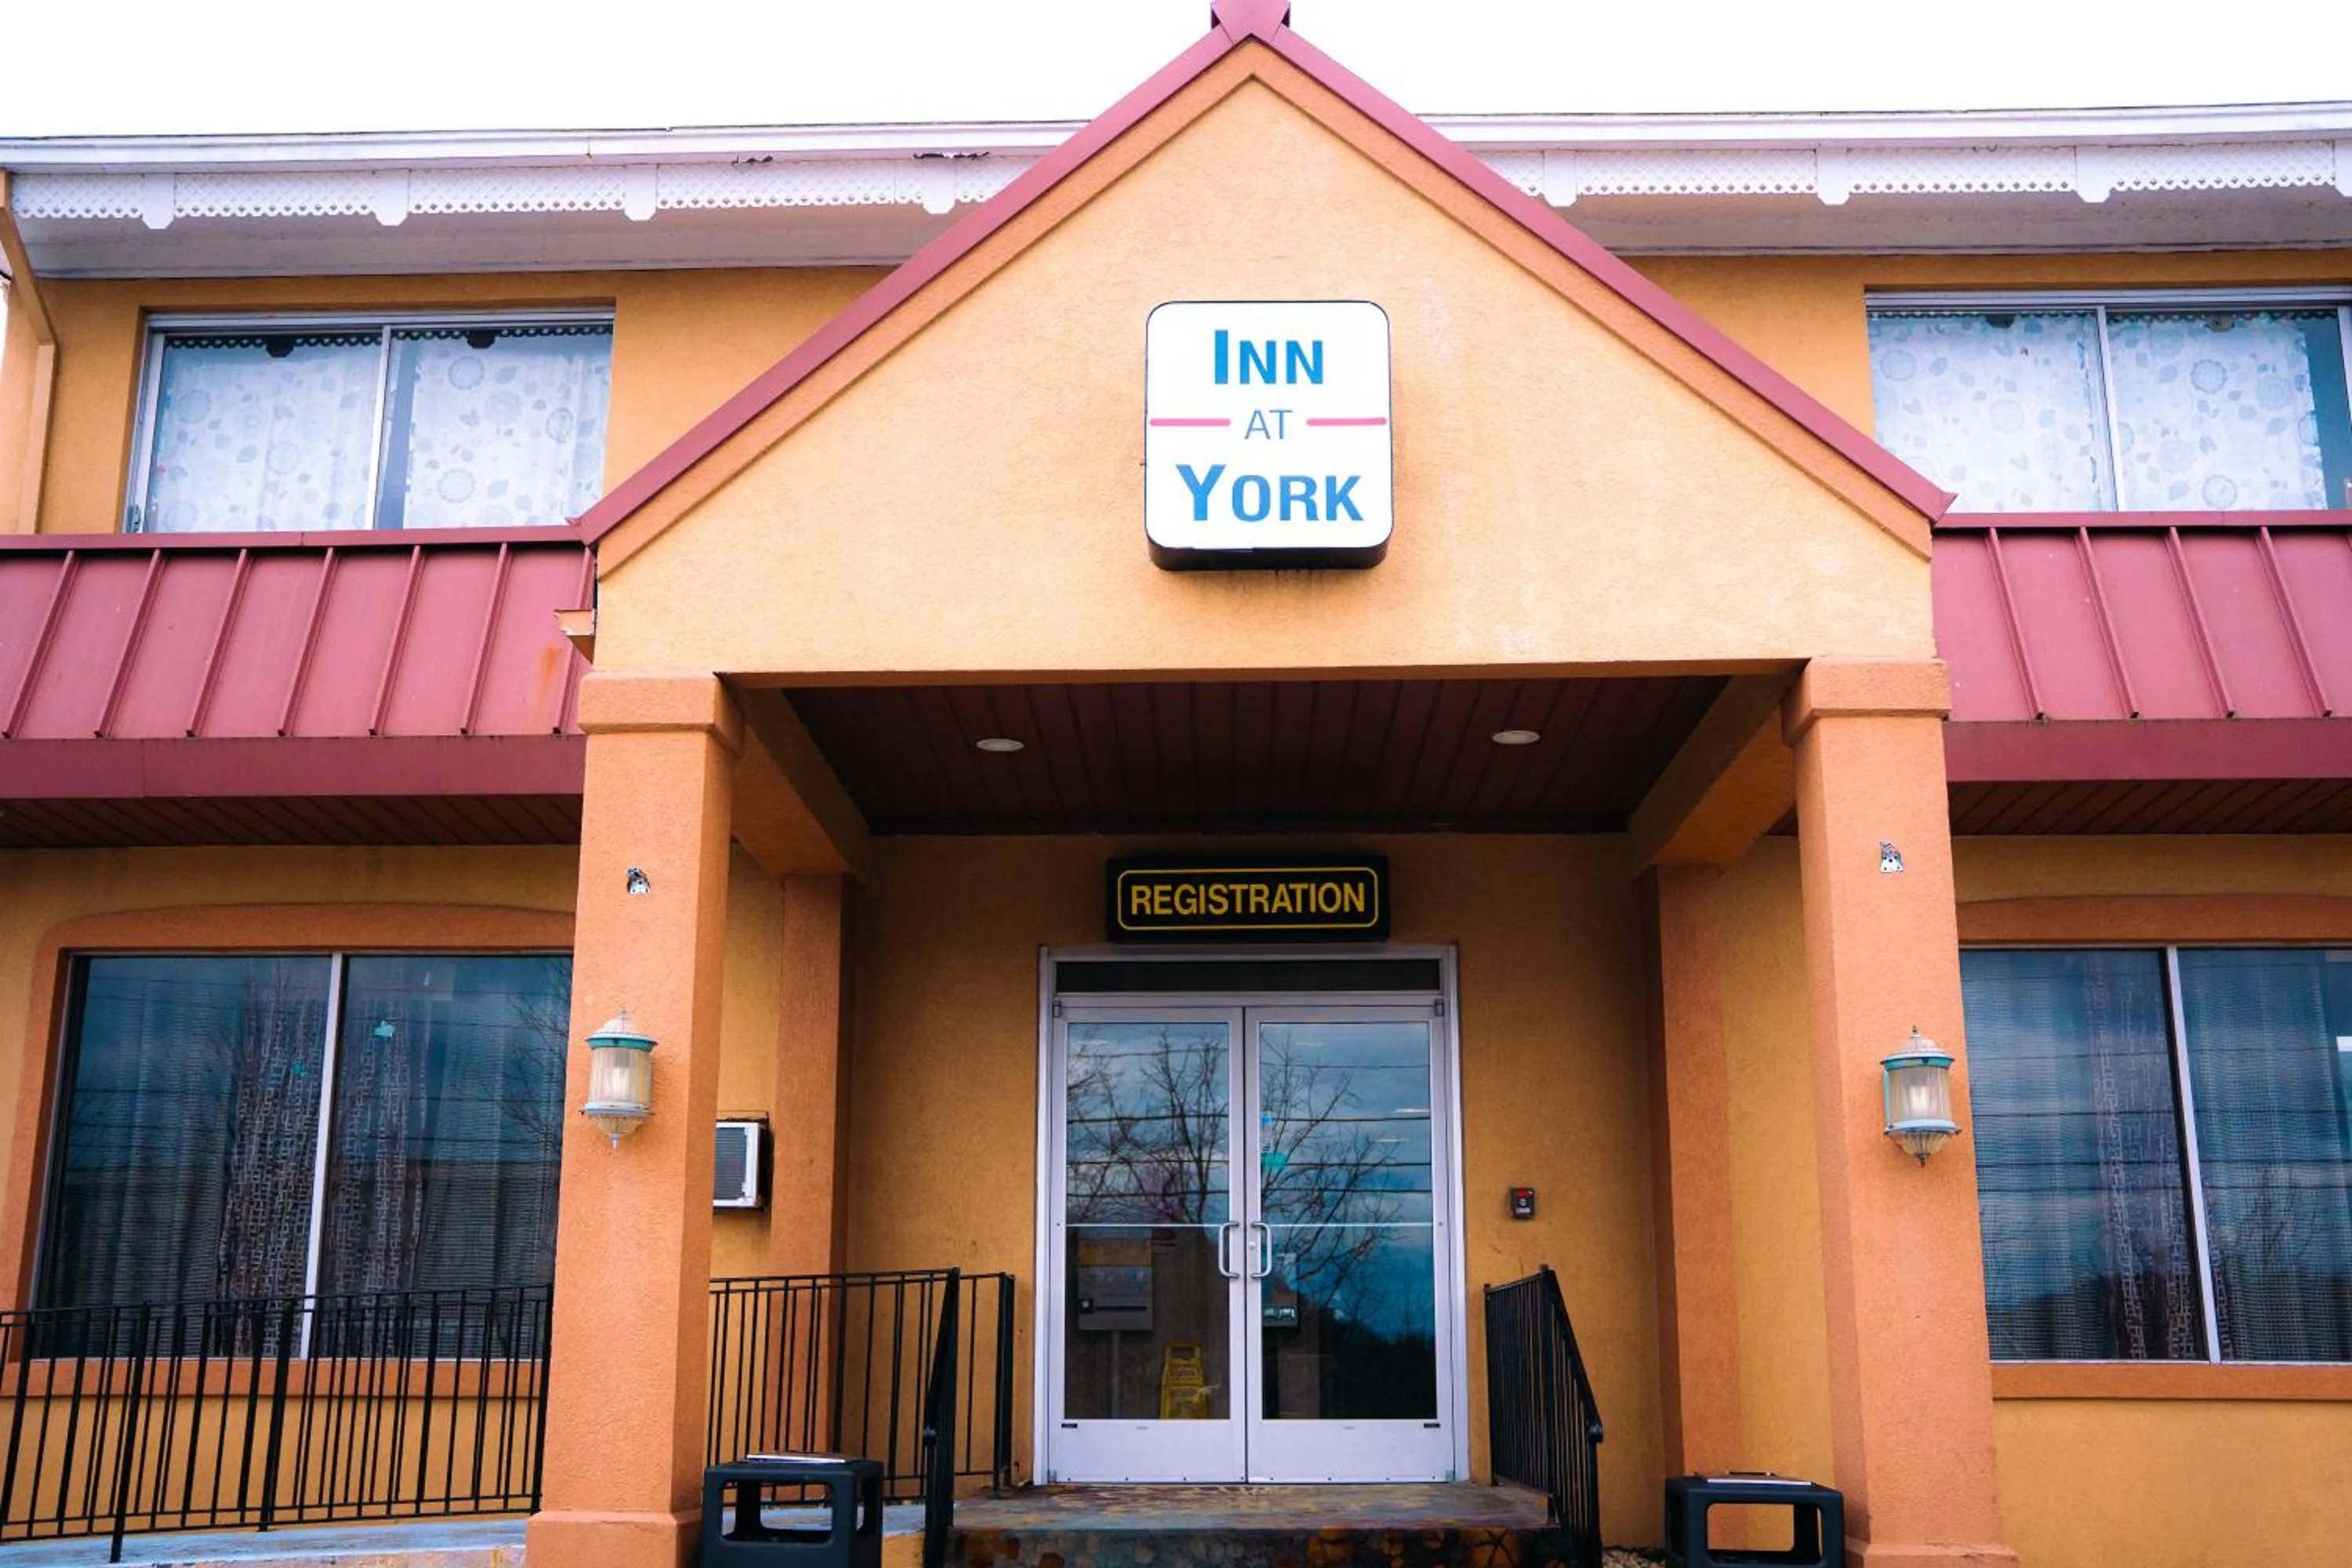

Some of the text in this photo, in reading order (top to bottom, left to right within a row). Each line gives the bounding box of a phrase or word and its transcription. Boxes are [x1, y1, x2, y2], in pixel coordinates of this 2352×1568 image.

[1214, 329, 1323, 385] INN
[1243, 409, 1293, 440] AT
[1174, 463, 1365, 522] YORK
[1130, 882, 1366, 916] REGISTRATION
